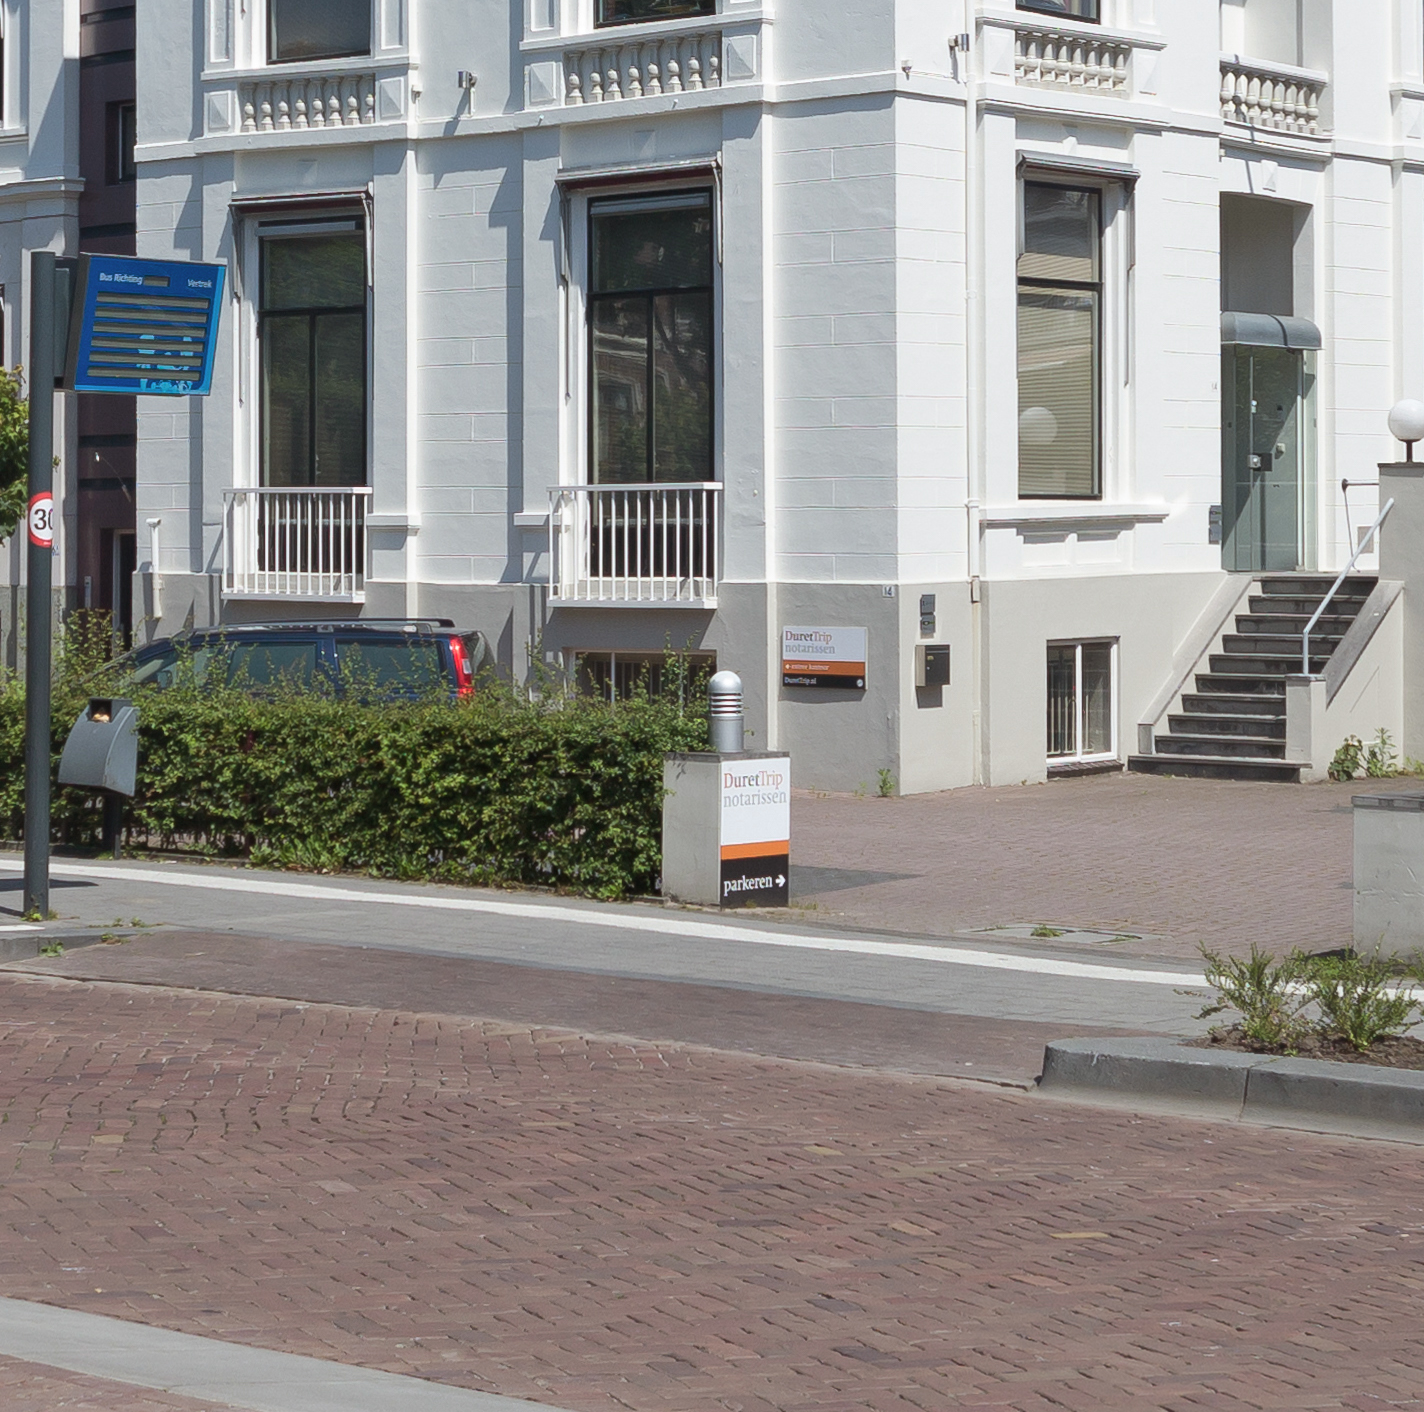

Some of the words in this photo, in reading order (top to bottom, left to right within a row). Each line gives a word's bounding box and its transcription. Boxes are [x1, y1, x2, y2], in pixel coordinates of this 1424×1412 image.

[99, 272, 113, 282] Bus
[114, 273, 144, 286] Richting
[785, 630, 833, 645] DuretTrip
[785, 643, 836, 655] notarissen
[723, 770, 783, 790] DuretTrip
[723, 789, 787, 808] notarissen
[723, 874, 773, 897] parkeren
